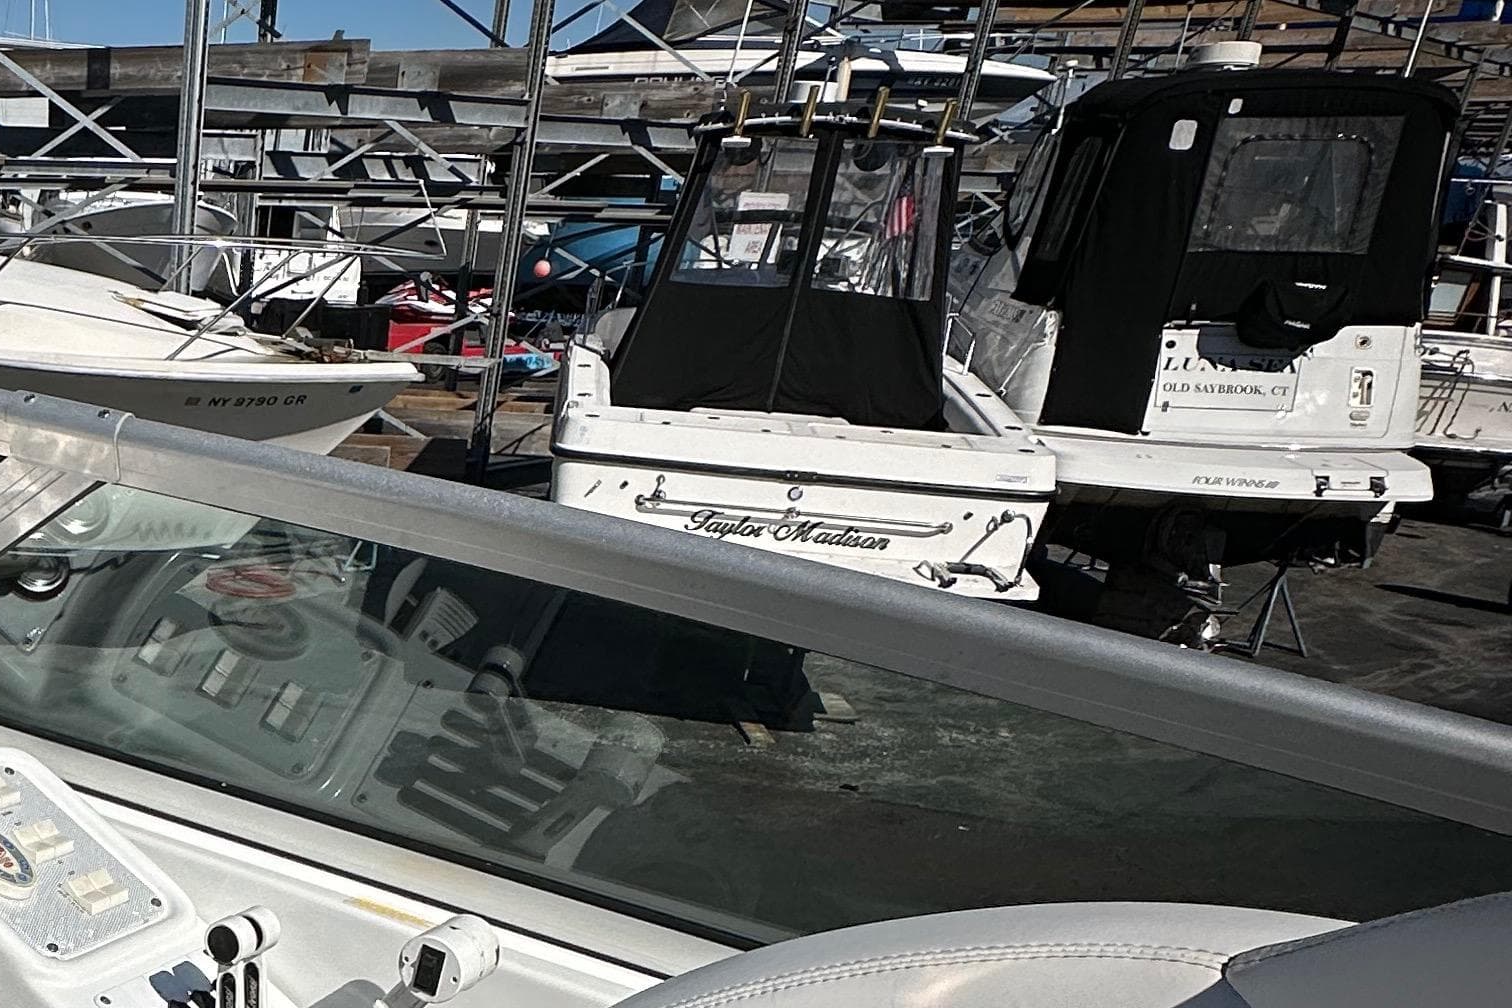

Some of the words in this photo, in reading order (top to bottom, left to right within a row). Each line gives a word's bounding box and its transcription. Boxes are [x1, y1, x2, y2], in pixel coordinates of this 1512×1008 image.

[1163, 382, 1190, 393] OLD
[1194, 383, 1267, 396] SAYBROOK,
[1271, 386, 1290, 396] CT
[208, 397, 232, 407] NY
[232, 396, 278, 408] 9790
[283, 394, 308, 406] GR
[684, 509, 766, 540] Taylor
[773, 520, 890, 550] Madison
